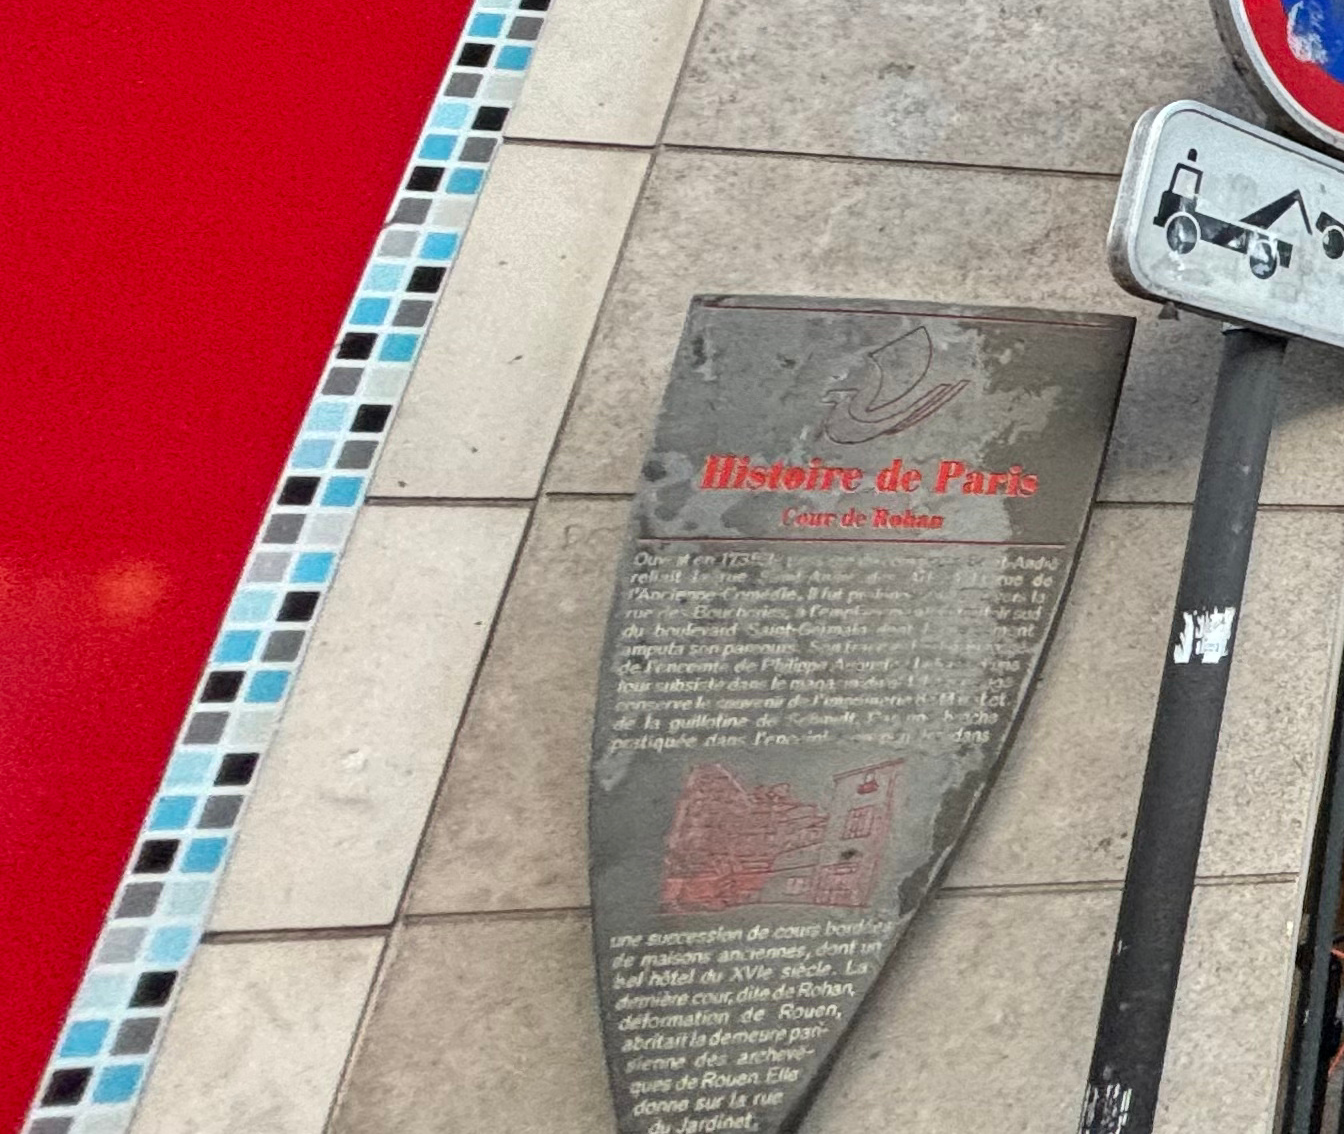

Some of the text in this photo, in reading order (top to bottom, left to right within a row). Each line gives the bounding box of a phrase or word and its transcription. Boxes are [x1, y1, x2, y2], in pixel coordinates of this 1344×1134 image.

[699, 452, 1039, 498] Histoire de Paris
[780, 505, 944, 529] Cour de Rohan
[1031, 573, 1054, 587] de
[622, 623, 645, 639] du
[621, 642, 686, 660] amputa
[688, 645, 721, 656] son
[733, 659, 758, 673] de
[612, 714, 638, 732] de
[643, 713, 661, 730] la
[668, 713, 750, 733] guillotine
[953, 727, 991, 746] dans
[609, 934, 643, 949] une
[645, 925, 743, 947] succession
[746, 924, 770, 941] de
[772, 925, 821, 939] cours
[611, 952, 636, 970] de
[640, 950, 711, 968] maisons
[814, 939, 858, 957] dont
[647, 968, 696, 987] hôtel
[699, 968, 724, 985] du
[845, 959, 869, 976] La
[735, 984, 771, 1004] dite
[771, 983, 796, 1001] de
[738, 1007, 766, 1025] de
[688, 1030, 708, 1049] la
[693, 1051, 728, 1069] des
[674, 1074, 699, 1093] de
[764, 1066, 801, 1086] Elle
[632, 1089, 785, 1118] donne sur la rue
